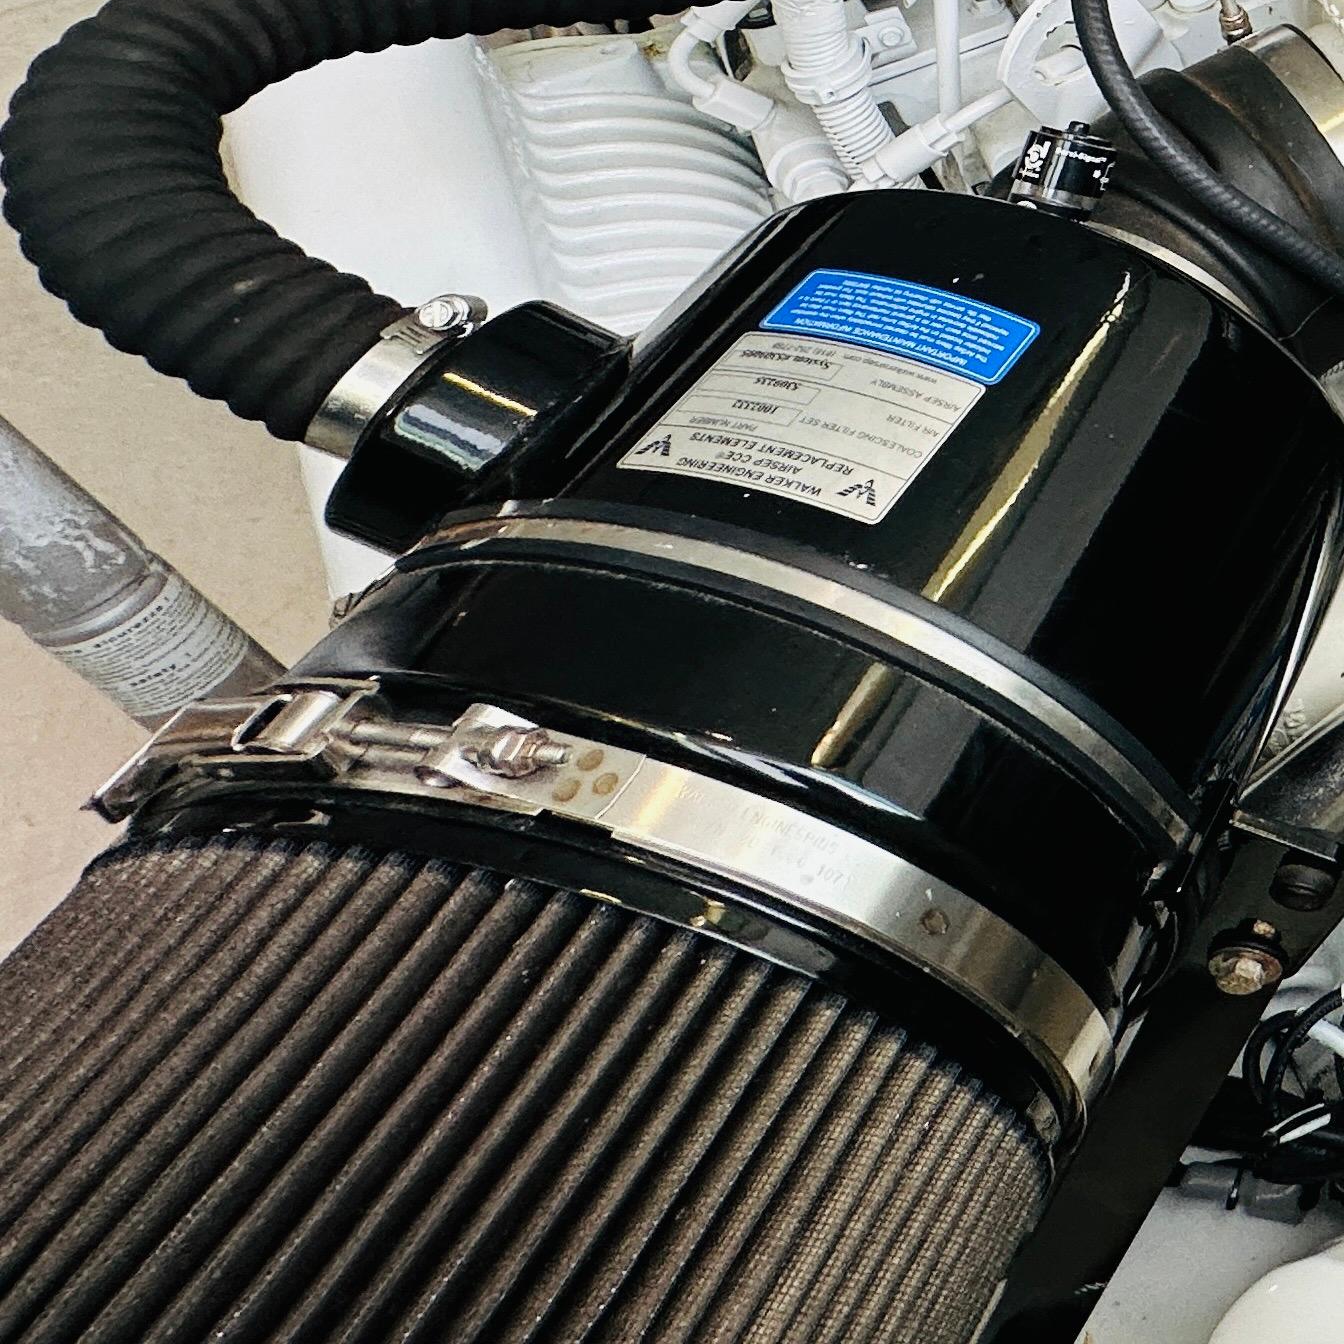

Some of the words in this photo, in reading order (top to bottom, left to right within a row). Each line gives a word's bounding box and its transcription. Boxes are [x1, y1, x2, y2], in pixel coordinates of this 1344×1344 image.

[850, 326, 917, 348] MAINTENANCE
[914, 343, 968, 366] IMPORTANT
[867, 377, 924, 398] ASSEMBLY
[922, 394, 962, 412] AIRSEP
[687, 415, 732, 427] NUMBER
[729, 420, 759, 433] PART
[797, 415, 821, 426] SET
[816, 420, 858, 436] FILTER
[882, 413, 925, 430] FILTER
[688, 431, 757, 449] ELEMENTS
[919, 425, 943, 437] AIR
[854, 429, 925, 458] COALESCING
[750, 456, 803, 474] AIRSEP
[756, 442, 854, 475] REPLACEMENT
[675, 457, 765, 479] ENGINEERING
[761, 474, 825, 496] WALKER
